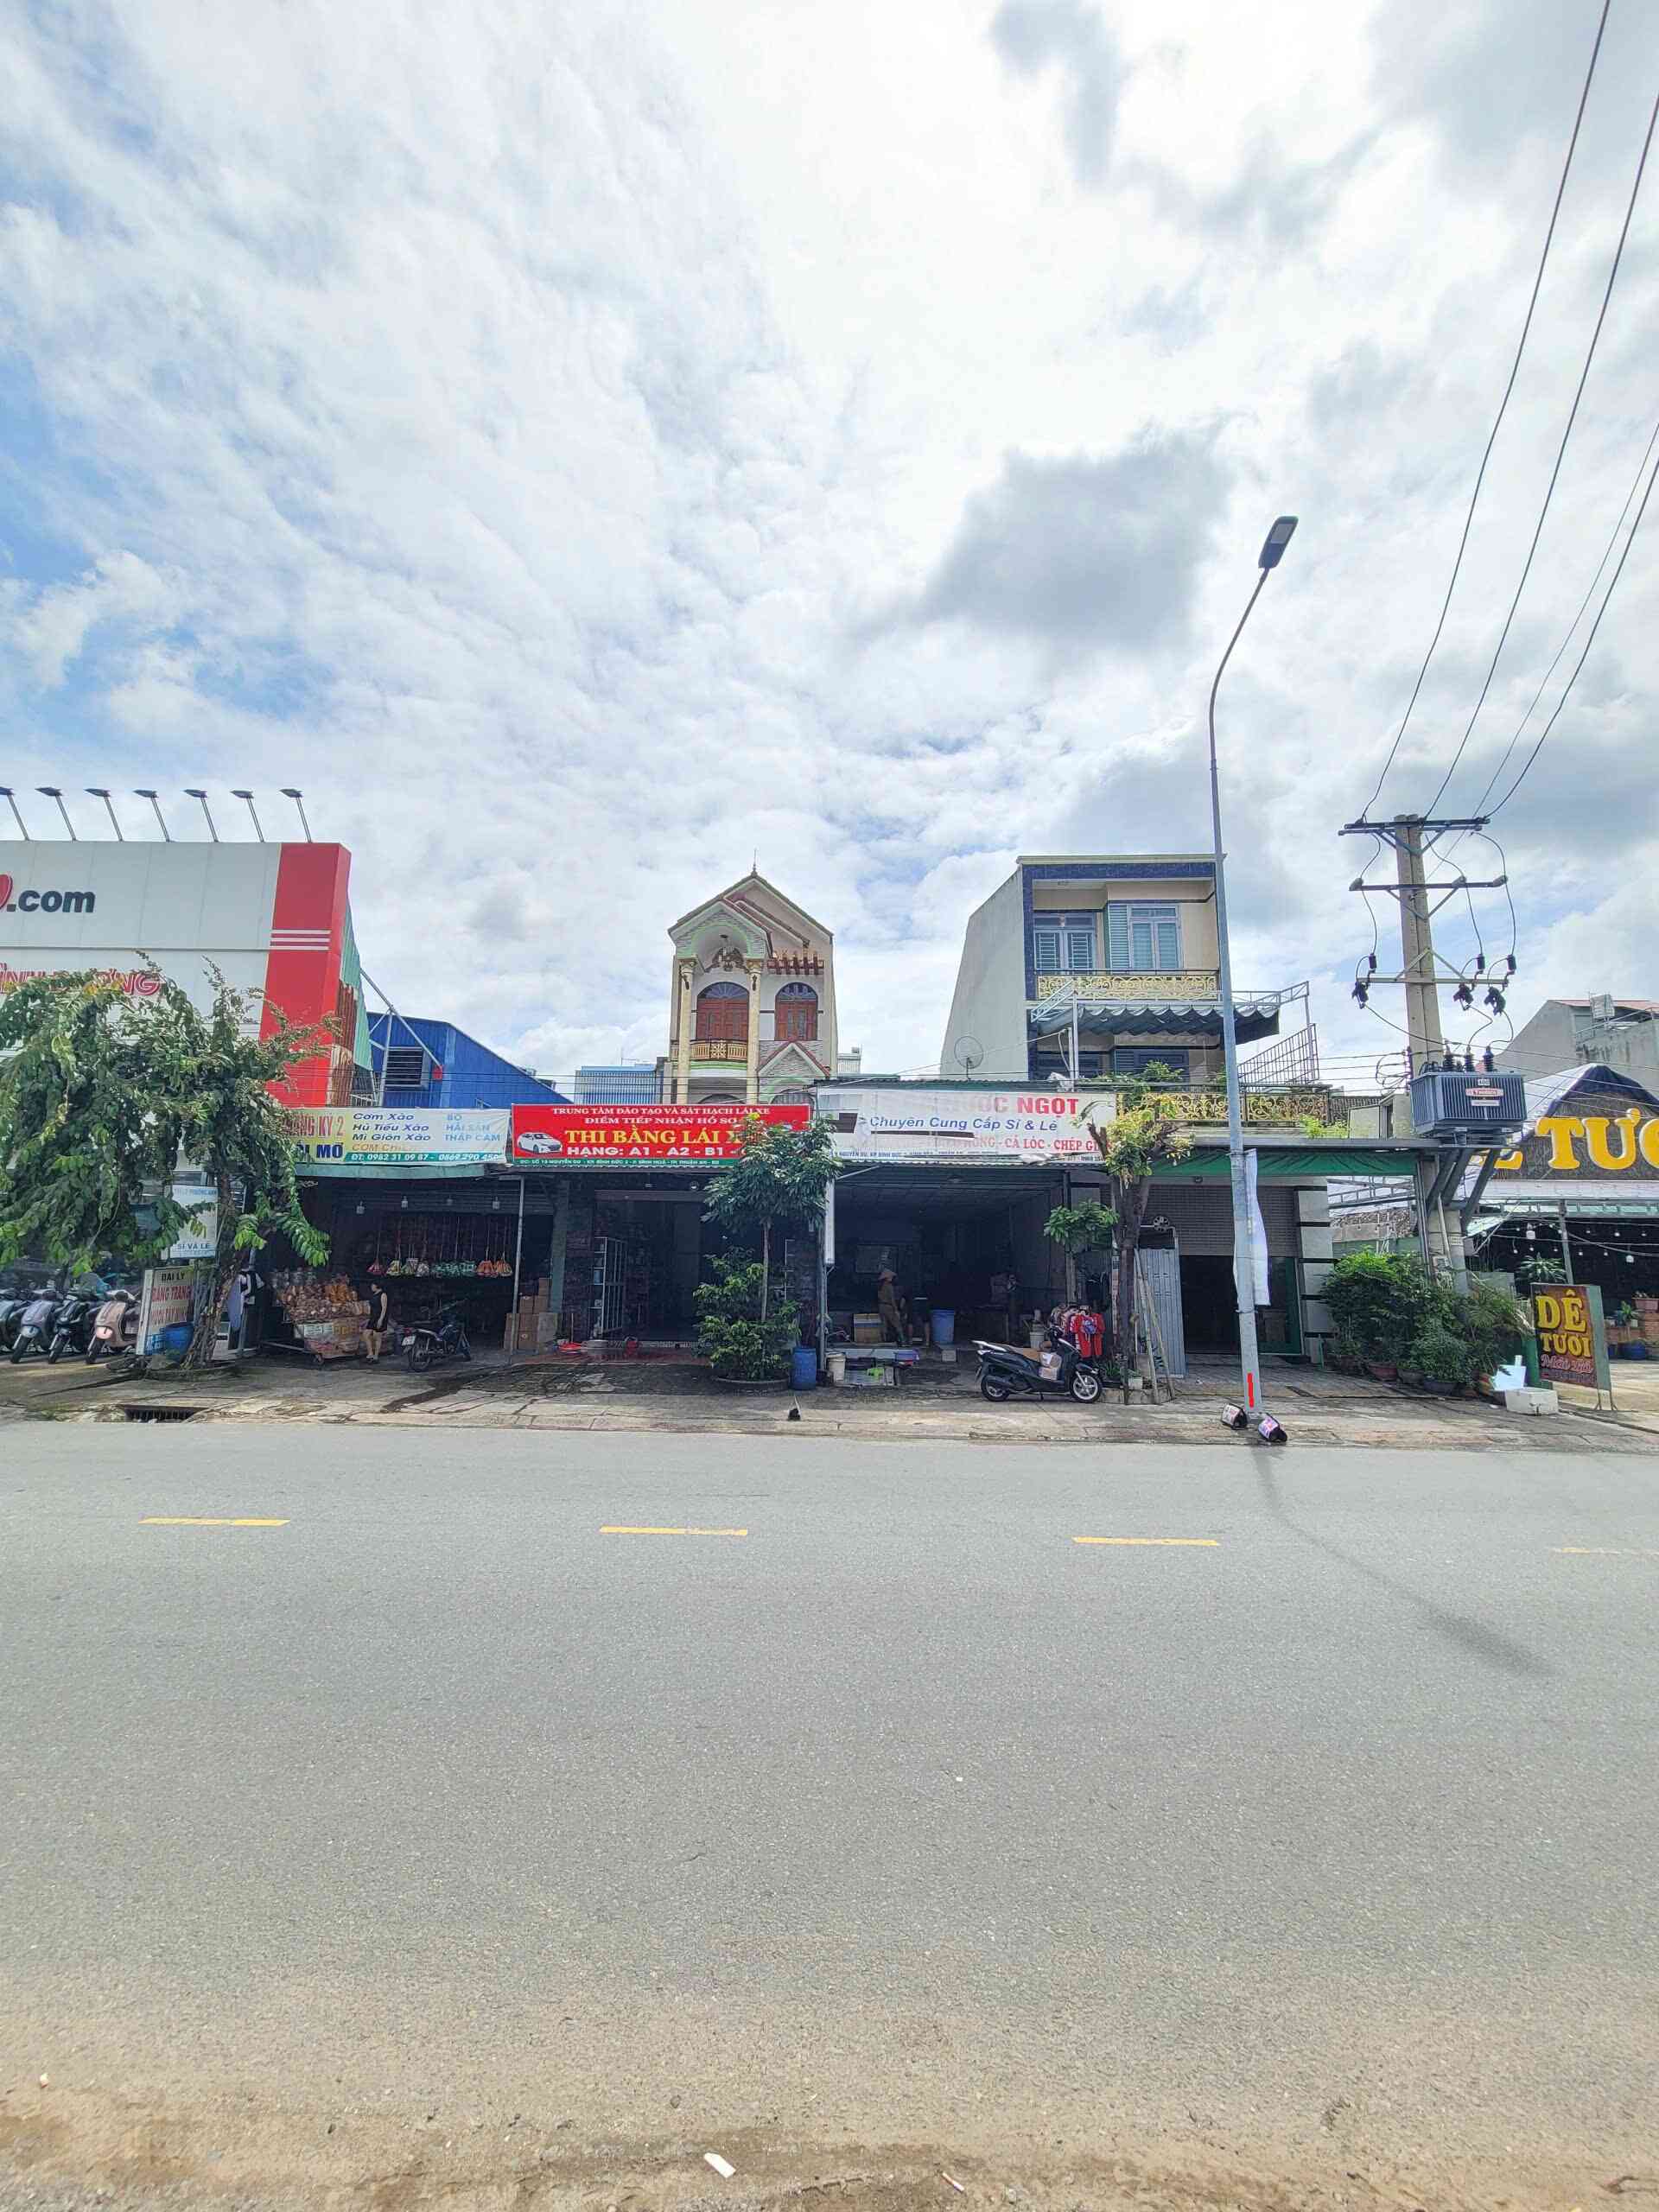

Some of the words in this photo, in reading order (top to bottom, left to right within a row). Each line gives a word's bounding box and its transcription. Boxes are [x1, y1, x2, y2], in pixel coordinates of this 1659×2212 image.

[1016, 1097, 1079, 1118] NGỌT
[654, 1117, 694, 1126] NHẬN
[870, 1116, 924, 1129] Chuyên
[930, 1118, 967, 1130] Cung
[973, 1116, 1001, 1132] Cấp
[564, 1130, 607, 1144] THI
[612, 1124, 677, 1144] BẰNG
[682, 1128, 721, 1144] LÁI
[567, 1147, 624, 1157] HẠNG:
[629, 1147, 650, 1155] A1
[666, 1147, 690, 1155] A2
[704, 1147, 723, 1155] B1
[1053, 1136, 1083, 1151] CHÉP
[1535, 1289, 1586, 1332] DÊ
[1540, 1332, 1592, 1357] TƯƠI
